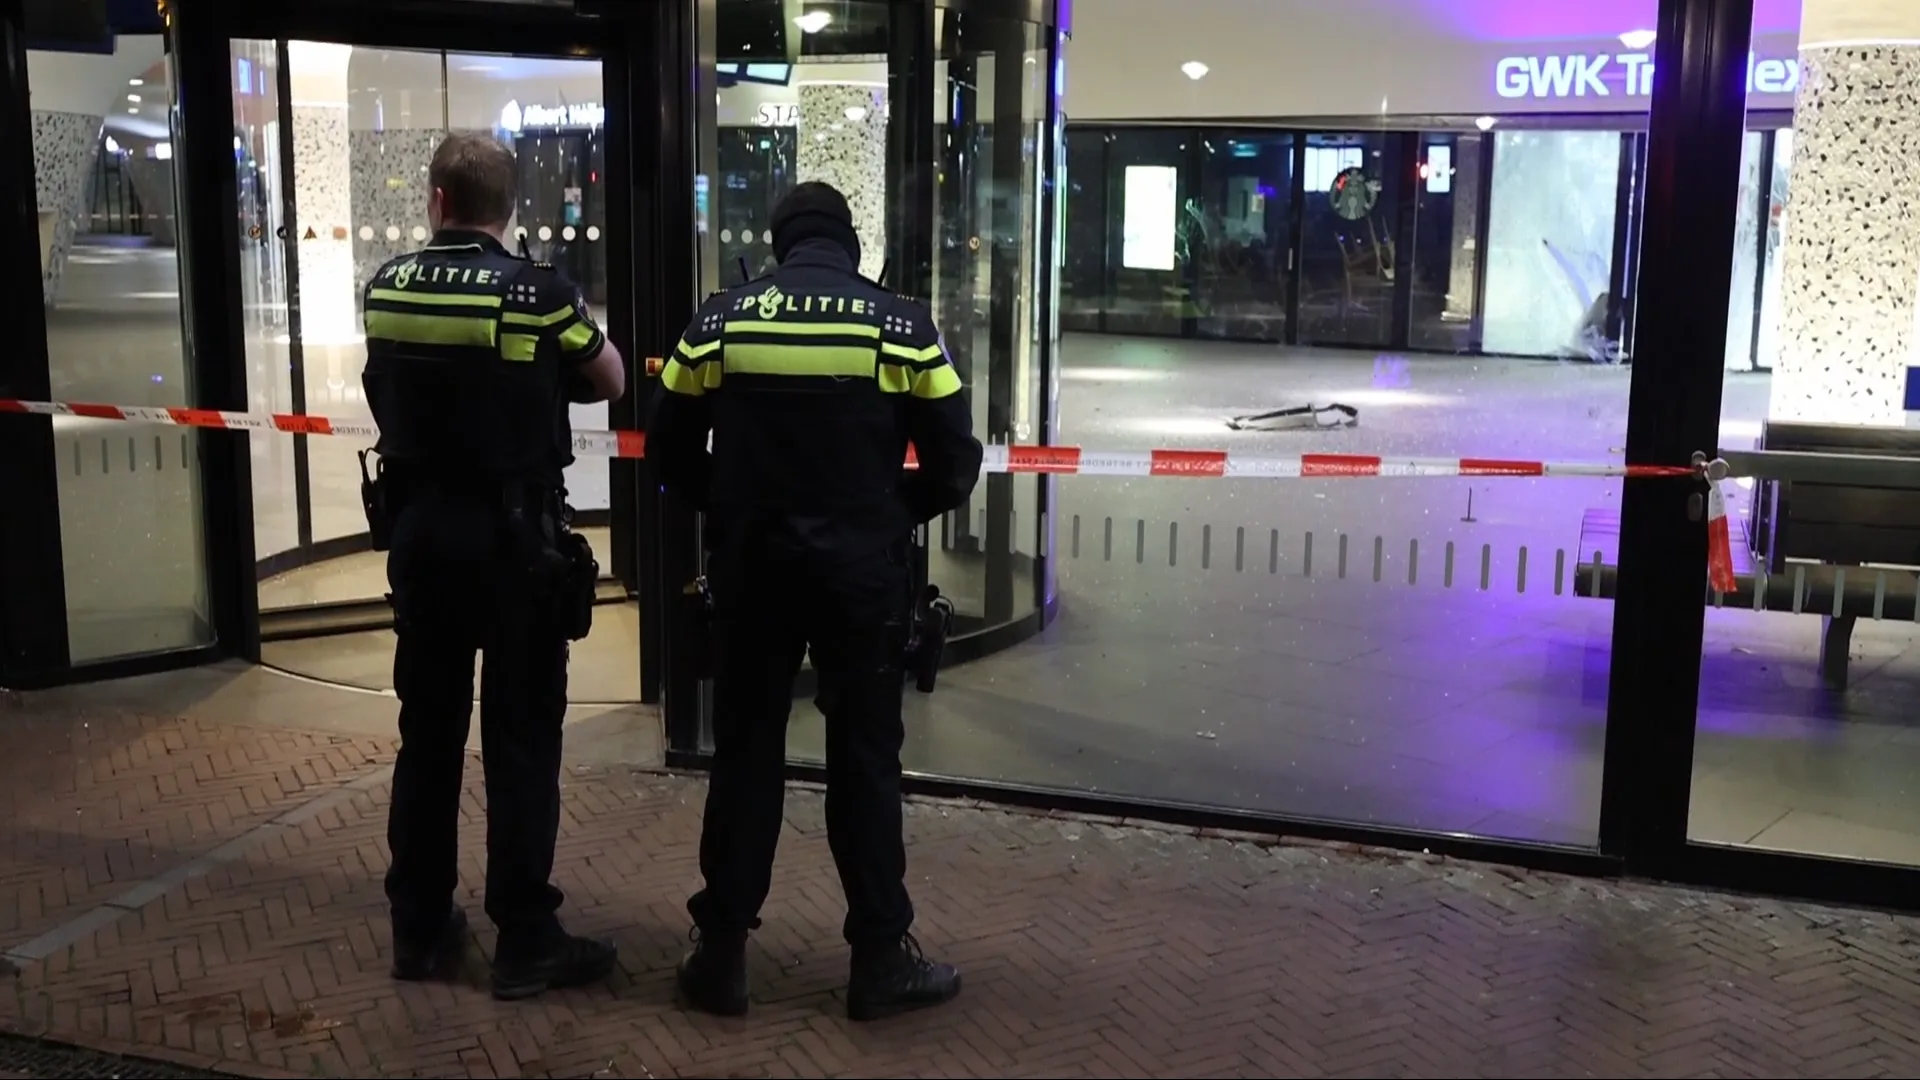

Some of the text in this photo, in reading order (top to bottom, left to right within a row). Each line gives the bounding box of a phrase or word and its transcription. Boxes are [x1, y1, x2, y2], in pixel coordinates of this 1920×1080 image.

[1496, 54, 1609, 97] GWK
[759, 105, 799, 123] STA
[742, 285, 866, 320] POLITIE
